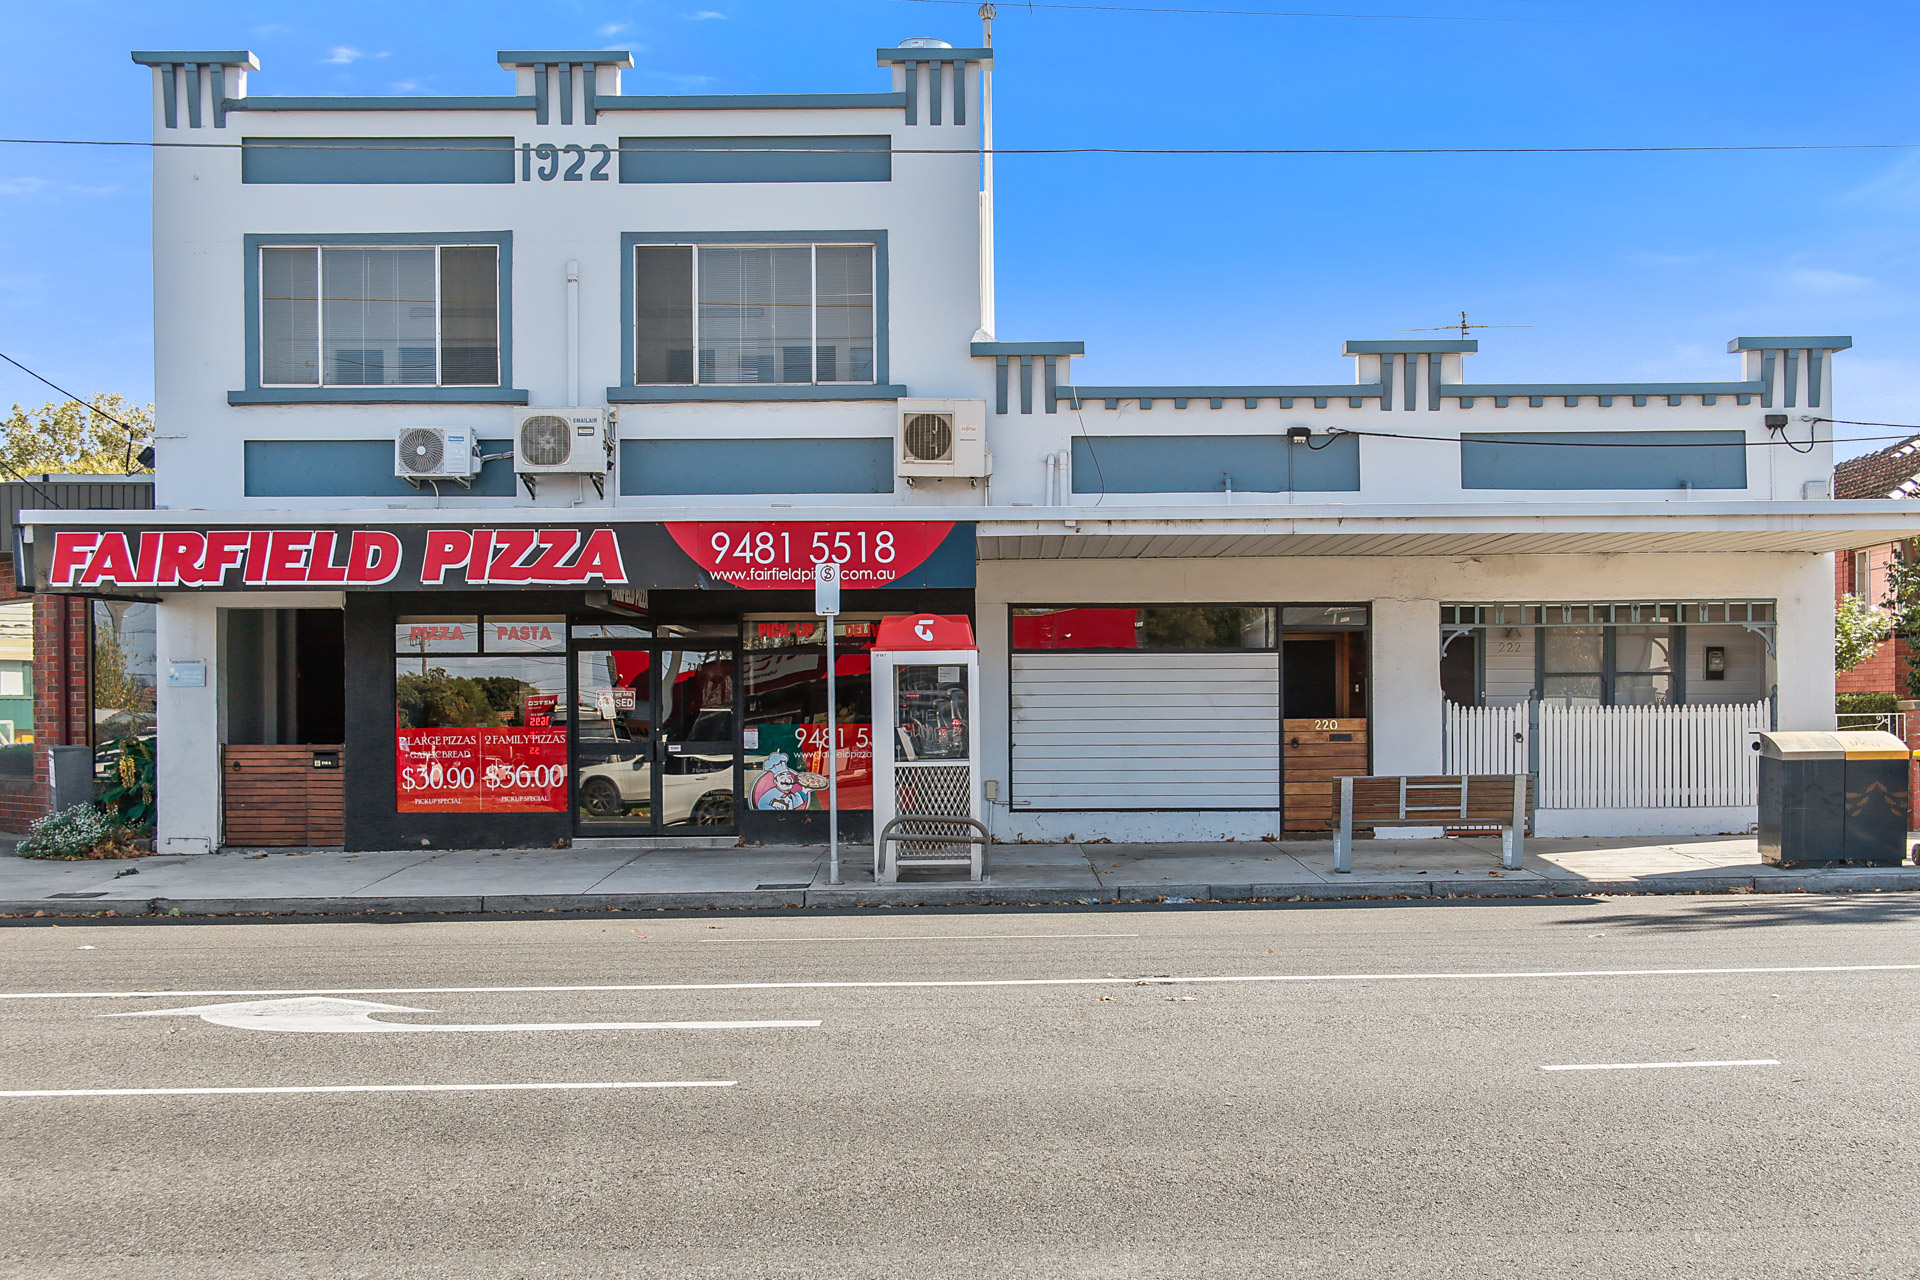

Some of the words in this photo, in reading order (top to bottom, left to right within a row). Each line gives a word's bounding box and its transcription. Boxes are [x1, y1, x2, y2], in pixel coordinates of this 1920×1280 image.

[522, 143, 611, 181] 1922
[711, 531, 791, 565] 9481
[809, 531, 896, 564] 5518
[50, 530, 403, 587] FAIRFIELD
[420, 528, 629, 584] PIZZA
[709, 566, 896, 582] www.fairfieldpicom.au
[410, 626, 465, 641] PIZZA
[497, 626, 552, 641] PASTA
[758, 622, 814, 638] PICK-UP
[1499, 641, 1521, 653] 222
[1314, 719, 1338, 730] 220
[399, 736, 407, 746] 2
[407, 735, 441, 746] LARGE
[443, 735, 477, 745] PIZZAS
[484, 735, 492, 745] 2
[493, 734, 530, 744] FAMILY
[532, 734, 566, 744] PIZZAS
[409, 750, 441, 759] GARLIC
[442, 750, 472, 758] BREAD
[402, 765, 475, 792] $30.90
[485, 763, 565, 791] $36.00
